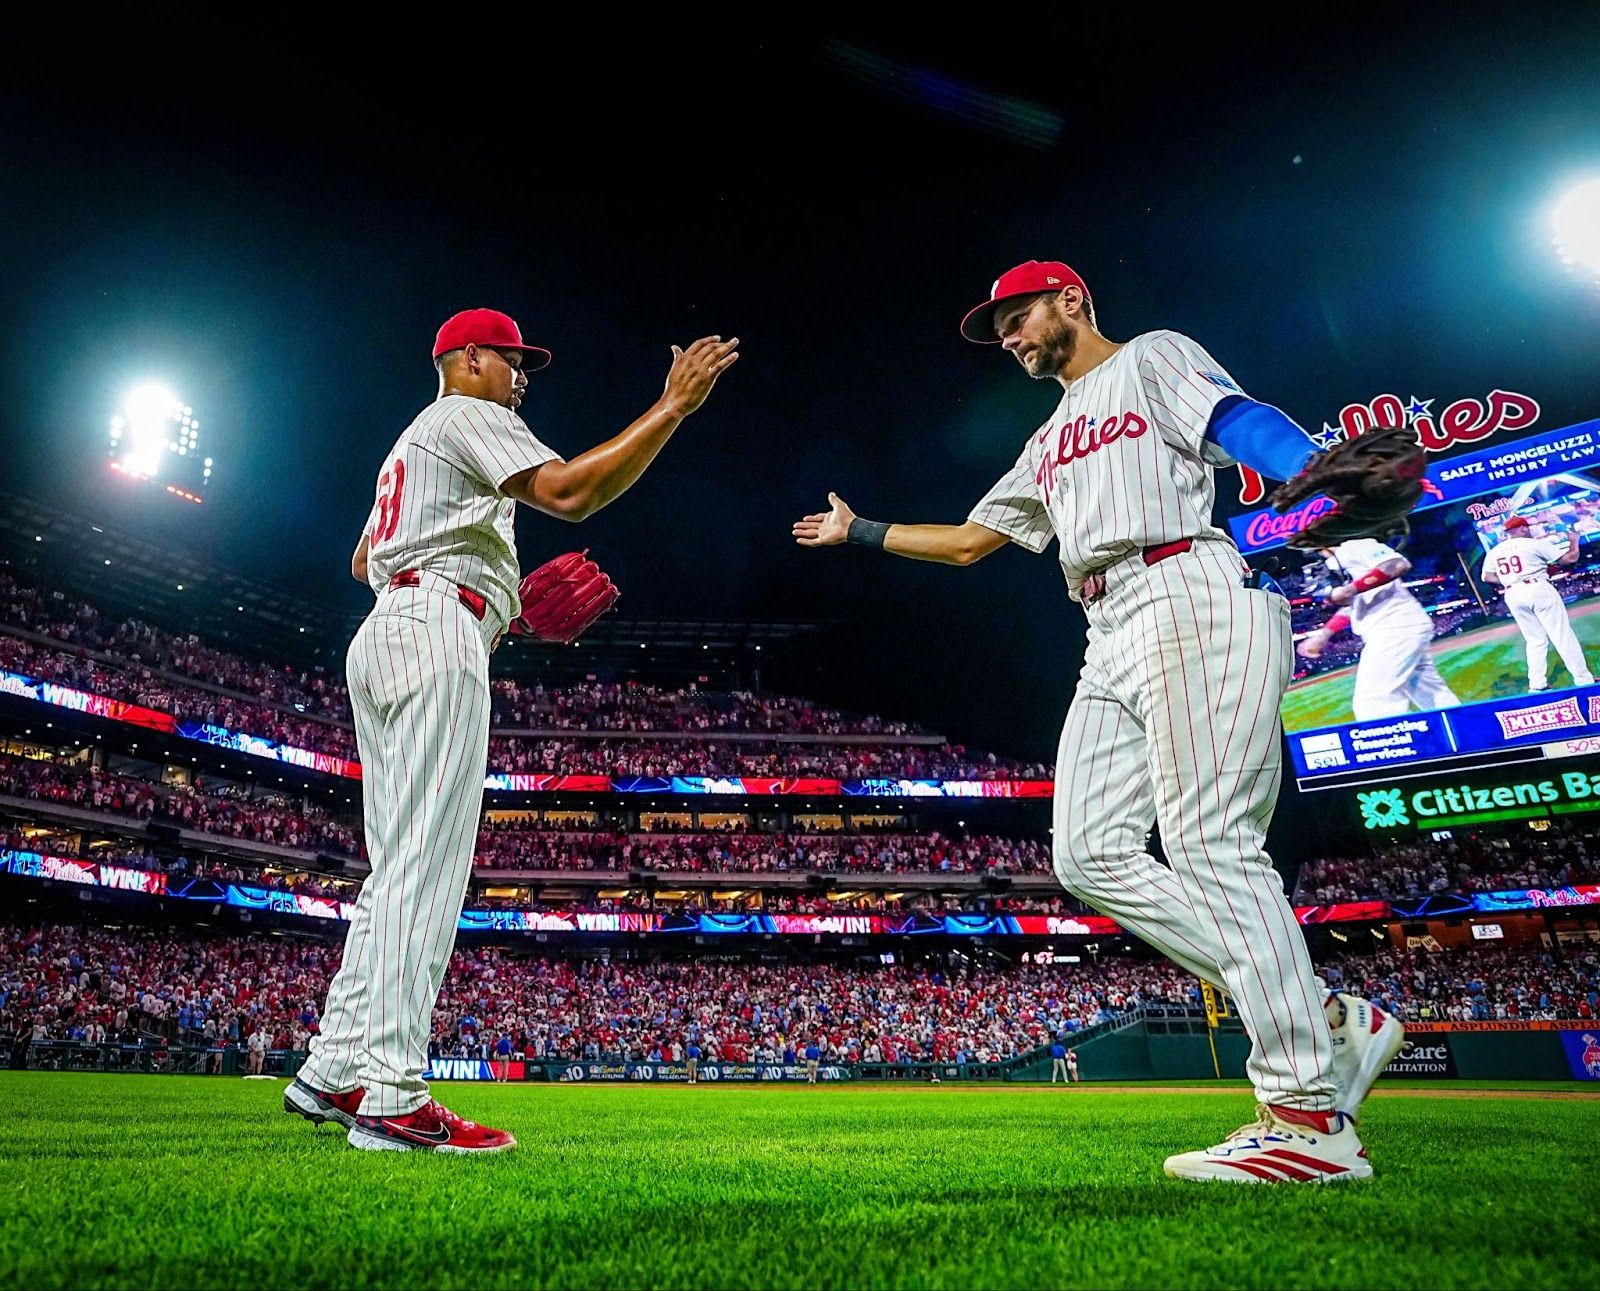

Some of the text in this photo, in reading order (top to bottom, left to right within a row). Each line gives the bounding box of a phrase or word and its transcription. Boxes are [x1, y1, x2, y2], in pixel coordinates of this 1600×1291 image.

[1440, 433, 1593, 482] SALTZ MONGELUZZI
[1488, 458, 1548, 481] INJURY
[1497, 555, 1522, 575] 59
[1507, 706, 1574, 732] MIKE'S
[1412, 781, 1559, 817] Citizens
[1526, 889, 1595, 908] Phillies
[1450, 1022, 1531, 1031] ASPLUNDH
[1394, 1041, 1447, 1060] Care
[431, 1059, 481, 1080] WIN!
[565, 1066, 584, 1081] 10
[637, 1065, 653, 1080] 10
[703, 1066, 719, 1080] 10
[766, 1066, 782, 1080] 10
